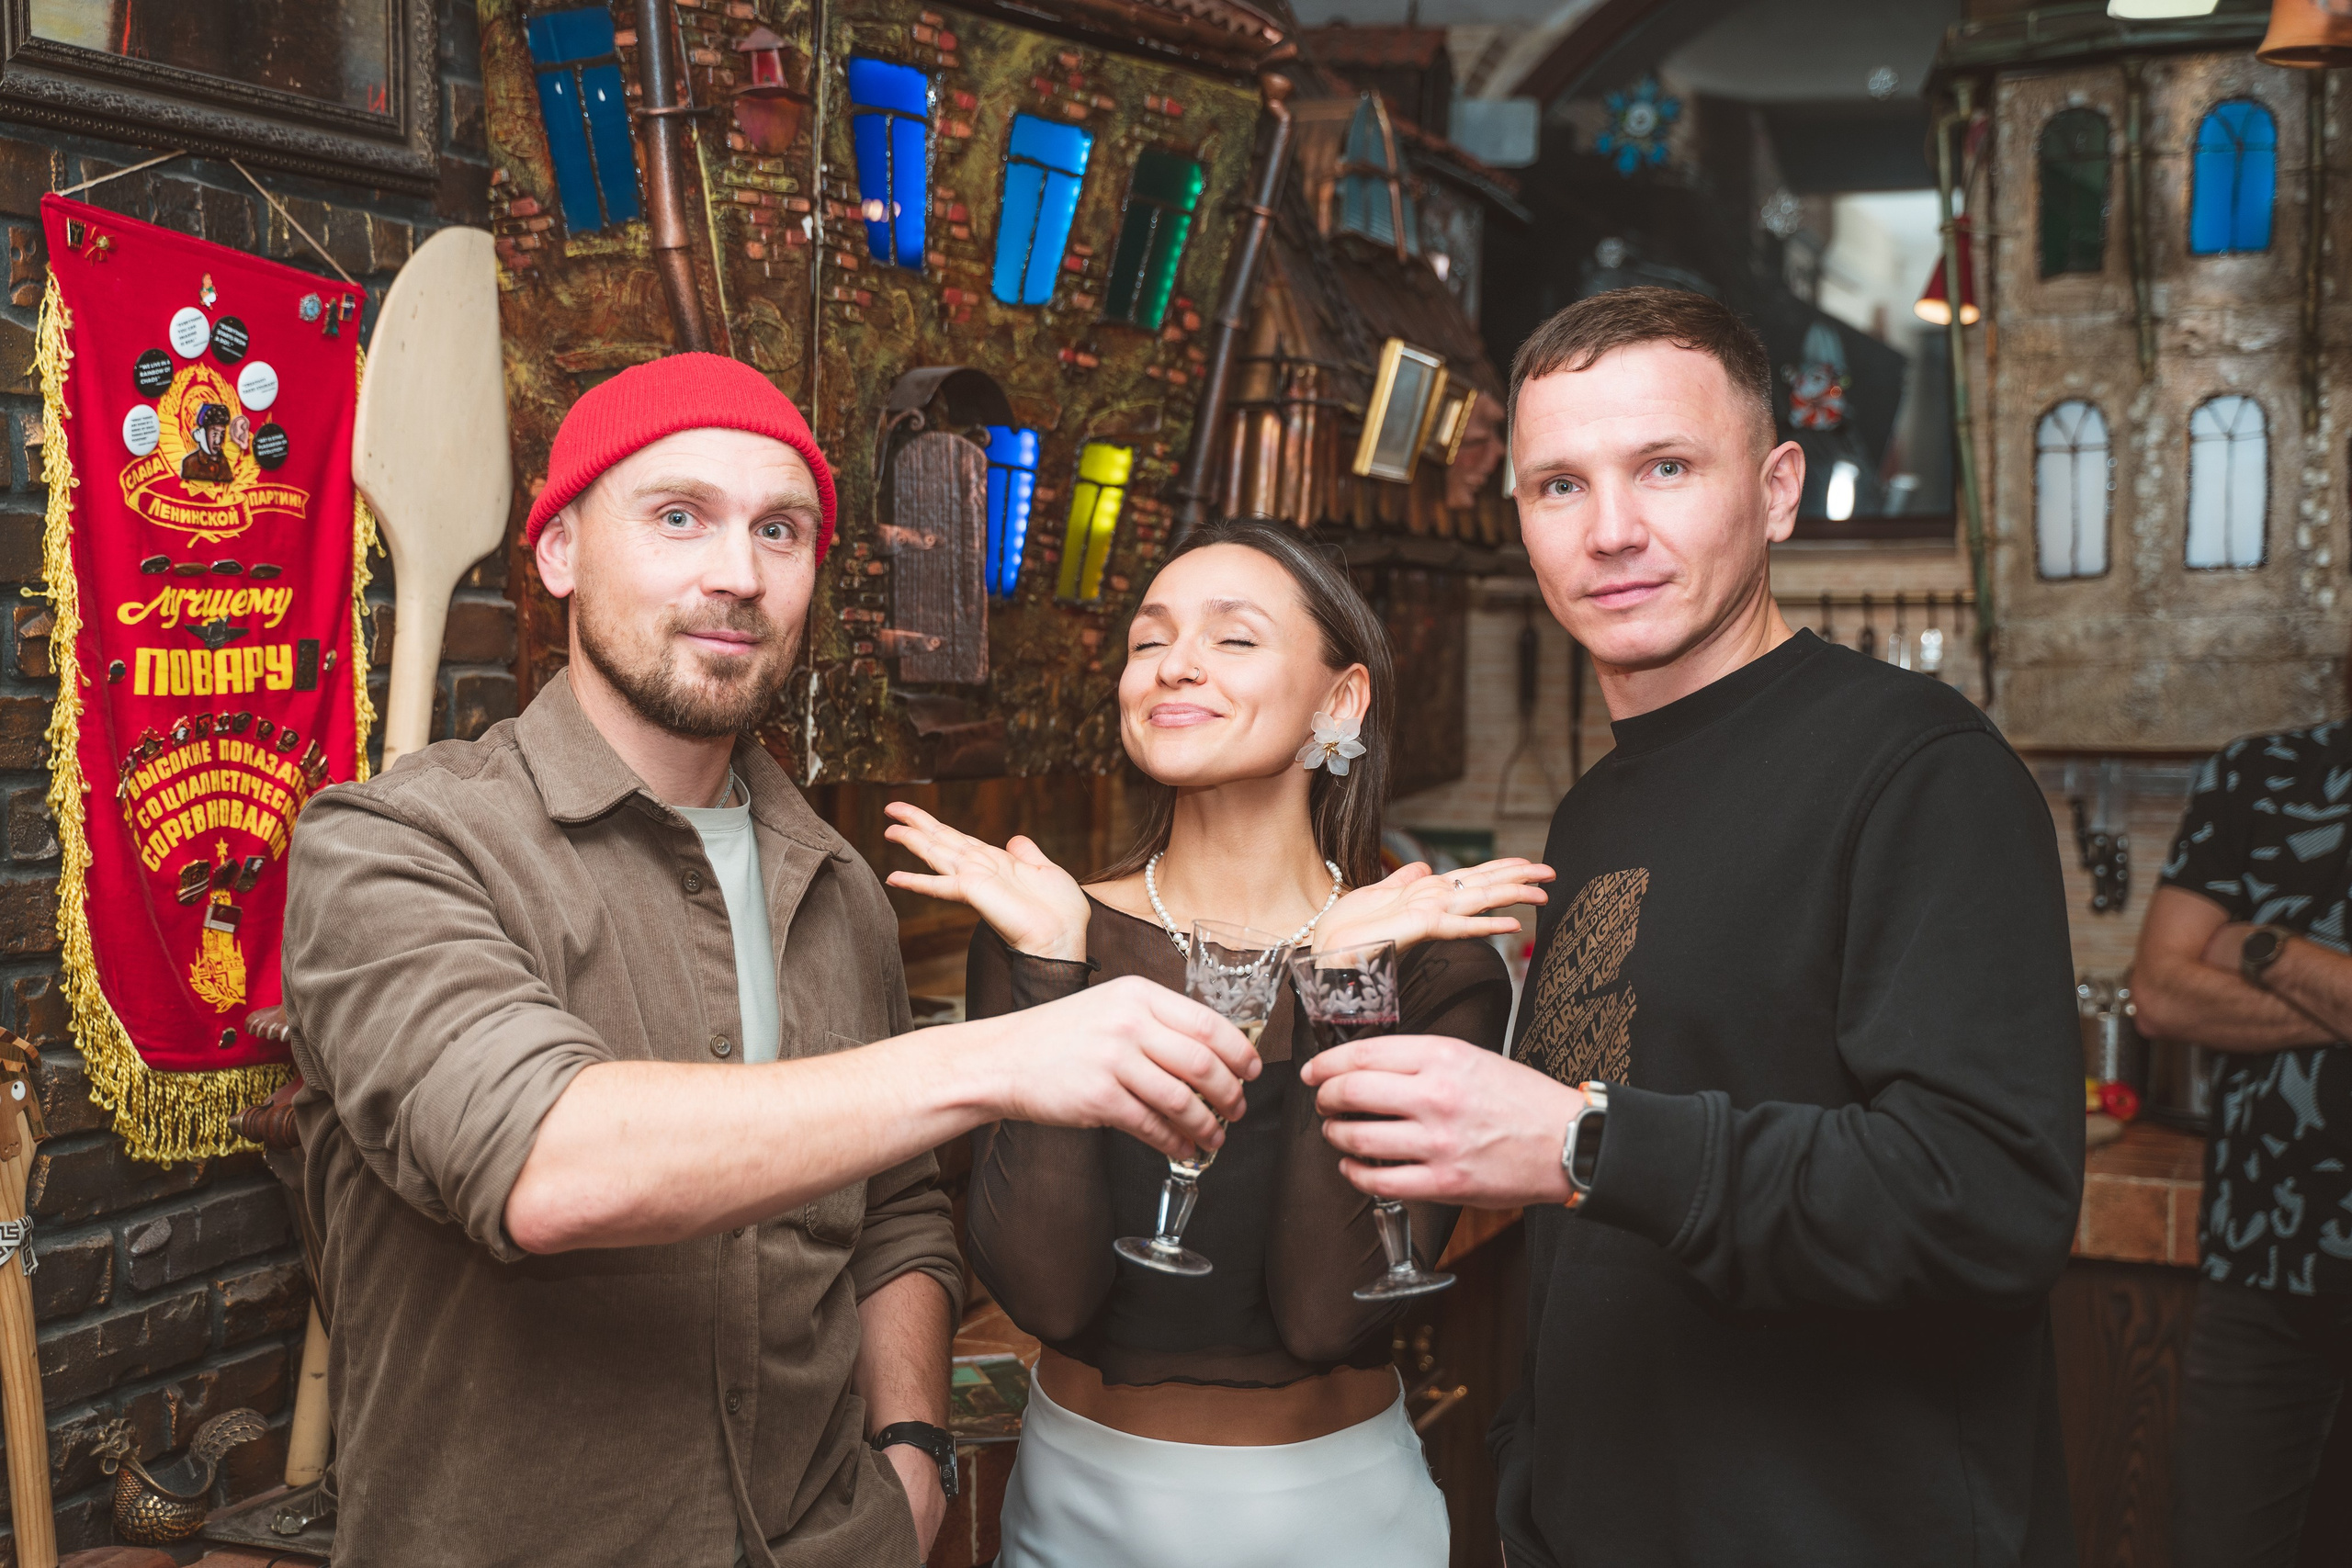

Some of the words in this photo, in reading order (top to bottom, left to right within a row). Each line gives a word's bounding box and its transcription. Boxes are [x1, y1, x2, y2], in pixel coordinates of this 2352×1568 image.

[125, 457, 165, 490] СЛАВА
[248, 490, 303, 509] ПАРТИИ!
[148, 497, 240, 527] ЛЕНИНСКОЙ
[133, 643, 294, 696] ПОВАРУ
[129, 739, 213, 801] ВЫСОКИЕ
[141, 797, 288, 874] СОРЕВНОВАНИИ
[1552, 913, 1597, 972] LAGERFELD
[1598, 891, 1621, 919] KARL
[1621, 866, 1647, 895] LAGE
[1534, 957, 1576, 1015] KARL
[1536, 1005, 1556, 1032] KARL
[1555, 952, 1602, 1009] LAGERFELD
[1603, 928, 1623, 955] KARL
[1541, 994, 1583, 1052] KARL
[1555, 1035, 1591, 1082] KARL
